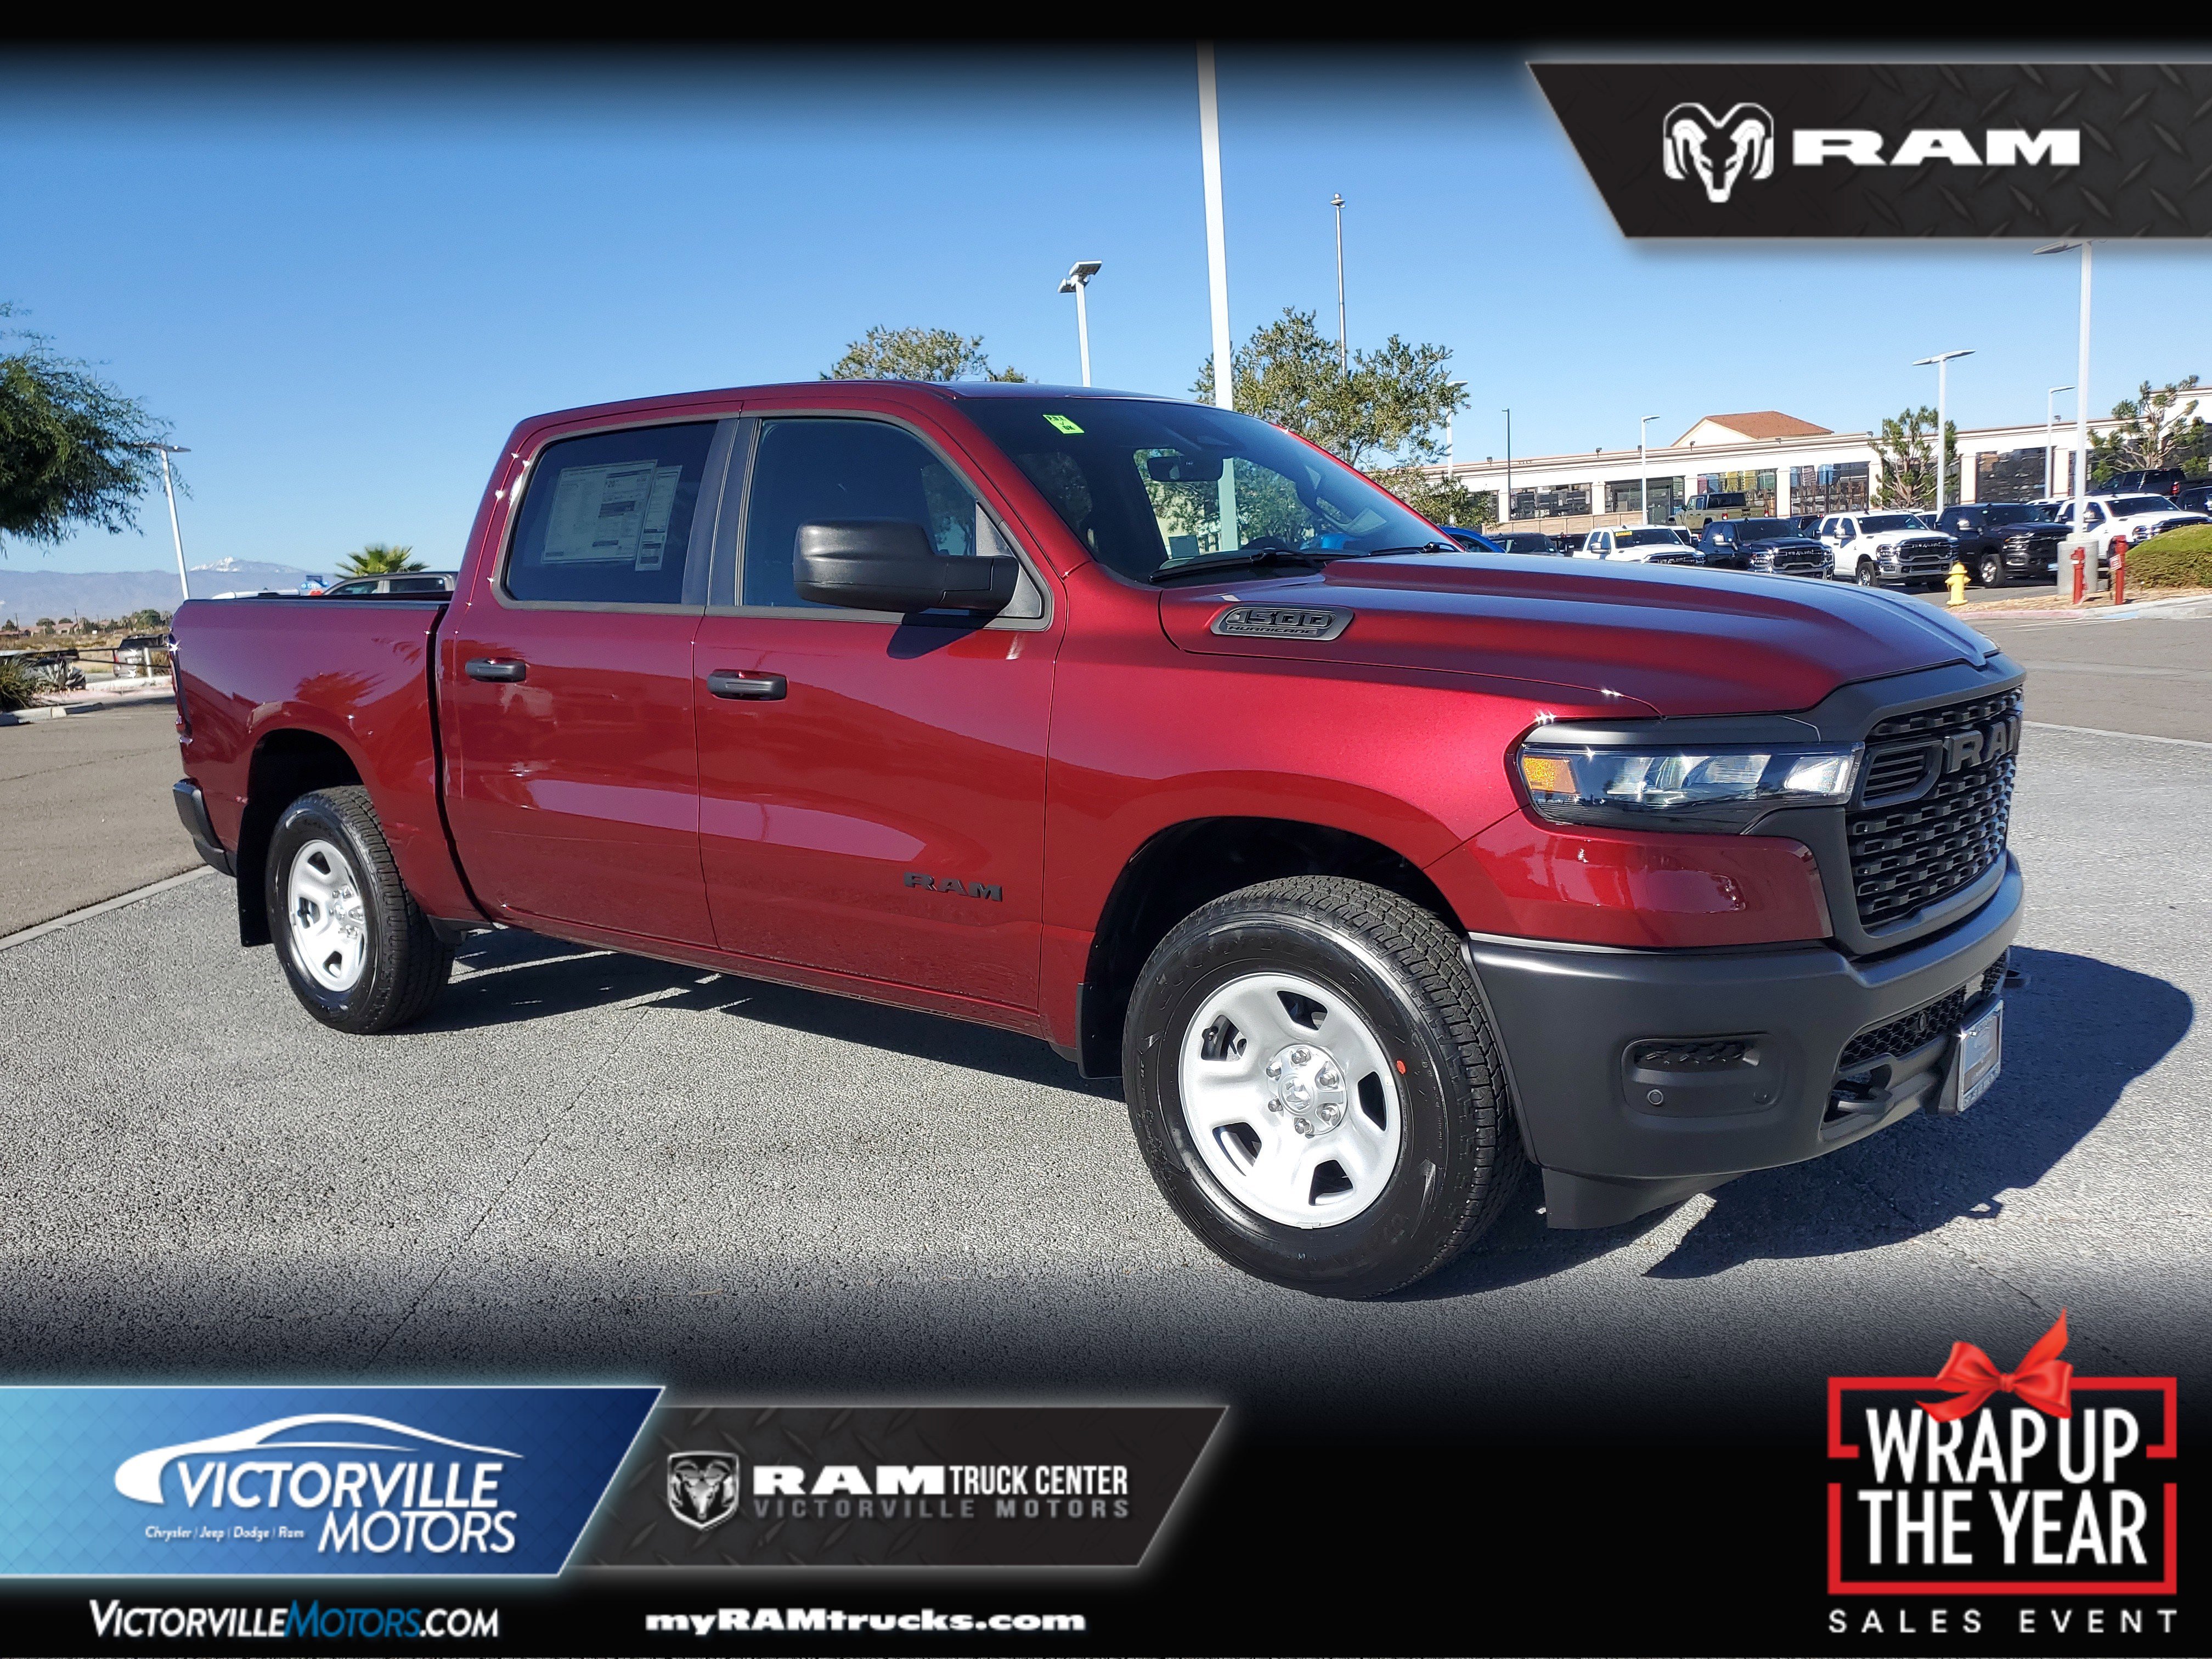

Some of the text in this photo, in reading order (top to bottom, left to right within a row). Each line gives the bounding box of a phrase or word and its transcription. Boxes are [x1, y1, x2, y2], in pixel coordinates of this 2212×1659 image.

[1227, 610, 1333, 627] 1500
[1228, 626, 1316, 634] HURRICANE
[904, 871, 1003, 902] RAM
